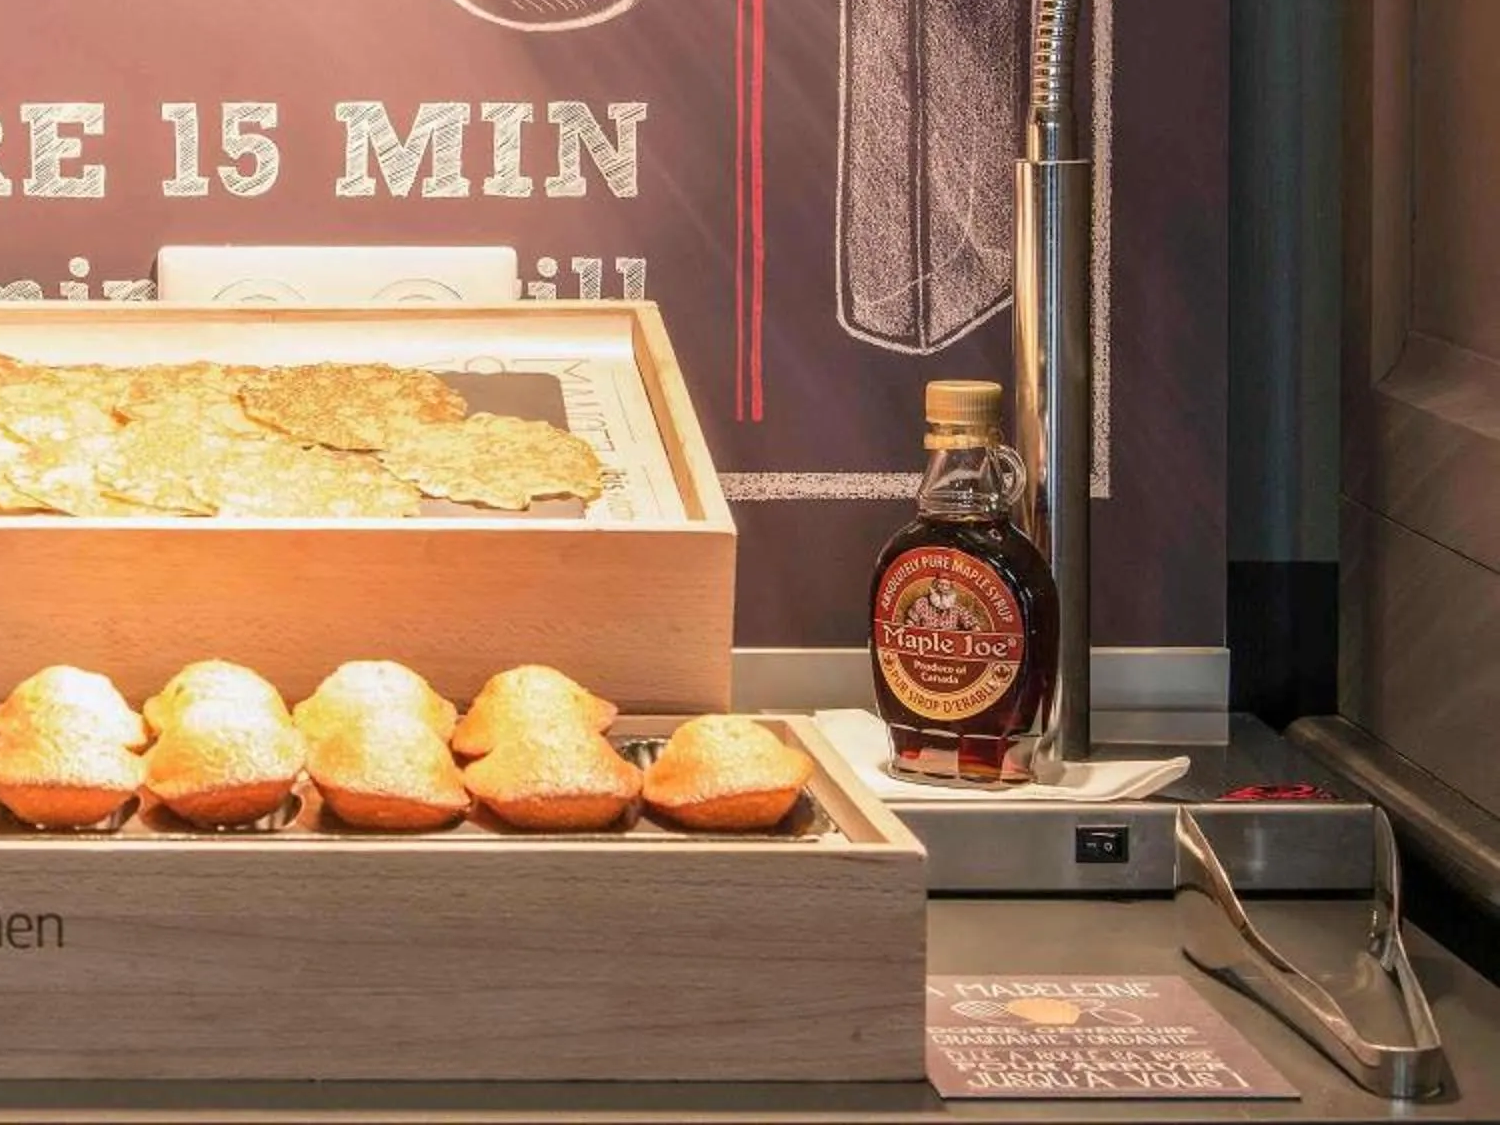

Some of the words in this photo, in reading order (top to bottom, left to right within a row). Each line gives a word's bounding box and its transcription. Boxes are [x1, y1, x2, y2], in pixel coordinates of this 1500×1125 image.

[161, 101, 280, 197] 15
[334, 101, 649, 198] MIN
[922, 555, 950, 569] PURE
[951, 560, 990, 590] MAPLE
[986, 586, 1013, 623] SYRUP
[883, 625, 955, 656] Maple
[954, 982, 1160, 998] MADELEINE
[1123, 1071, 1223, 1088] VOUS
